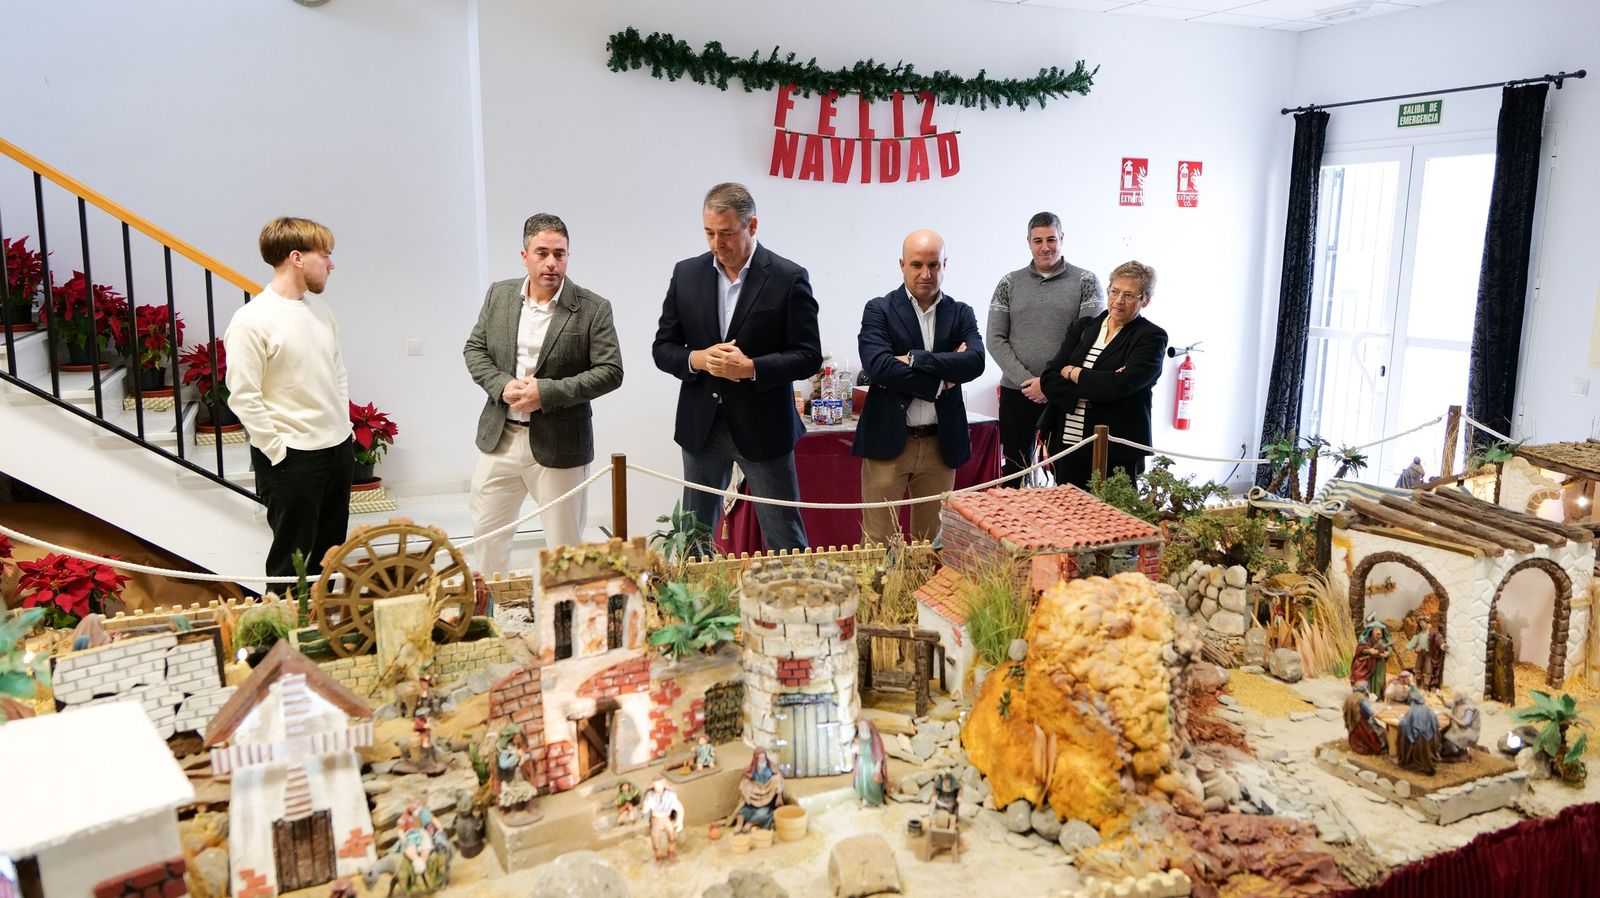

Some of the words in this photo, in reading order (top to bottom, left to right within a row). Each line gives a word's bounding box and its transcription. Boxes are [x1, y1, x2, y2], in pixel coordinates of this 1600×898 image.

[774, 84, 938, 138] FELIZ
[1400, 113, 1439, 126] EMERGENCIA
[1403, 104, 1425, 115] SALIDA
[1429, 102, 1438, 113] DE
[769, 129, 961, 184] NAVIDAD
